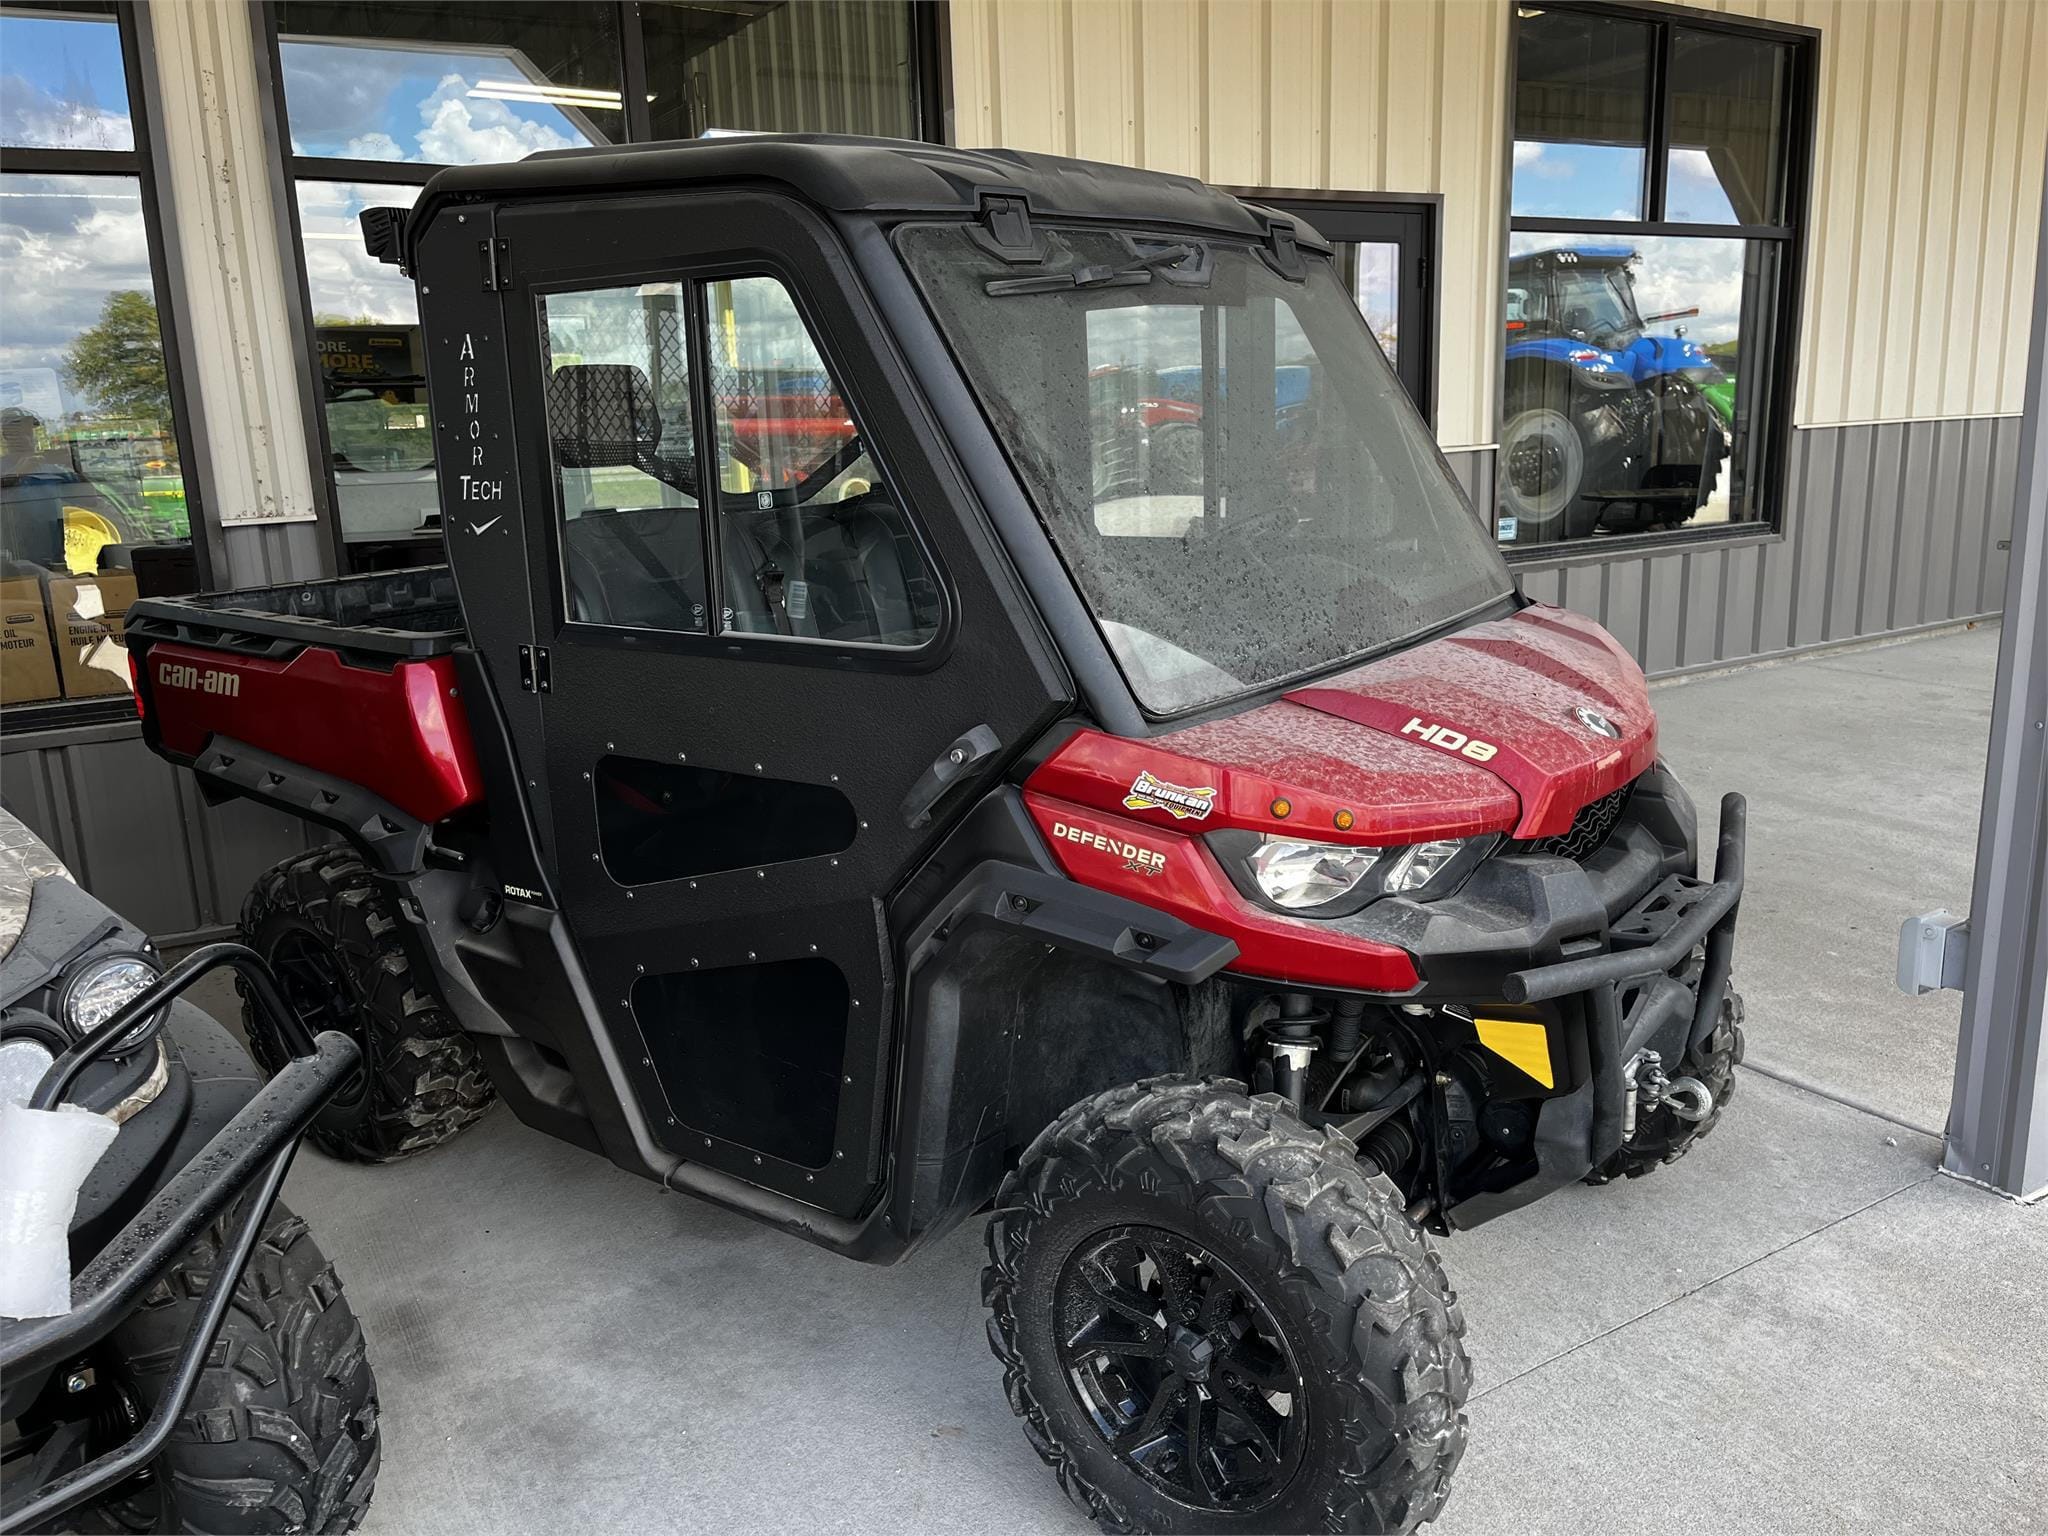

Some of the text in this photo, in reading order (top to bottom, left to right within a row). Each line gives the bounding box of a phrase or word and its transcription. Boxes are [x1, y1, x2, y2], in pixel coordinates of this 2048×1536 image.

[460, 333, 483, 466] ARMOR
[4, 629, 18, 638] OIL
[68, 623, 114, 635] ENGINE OIL
[0, 638, 35, 650] MOTEUR
[70, 636, 95, 647] HUILE
[159, 662, 240, 697] can-am
[1400, 717, 1498, 762] HD8
[1053, 822, 1166, 869] DEFENDER
[1122, 860, 1162, 876] XT
[504, 885, 531, 899] ROTAX
